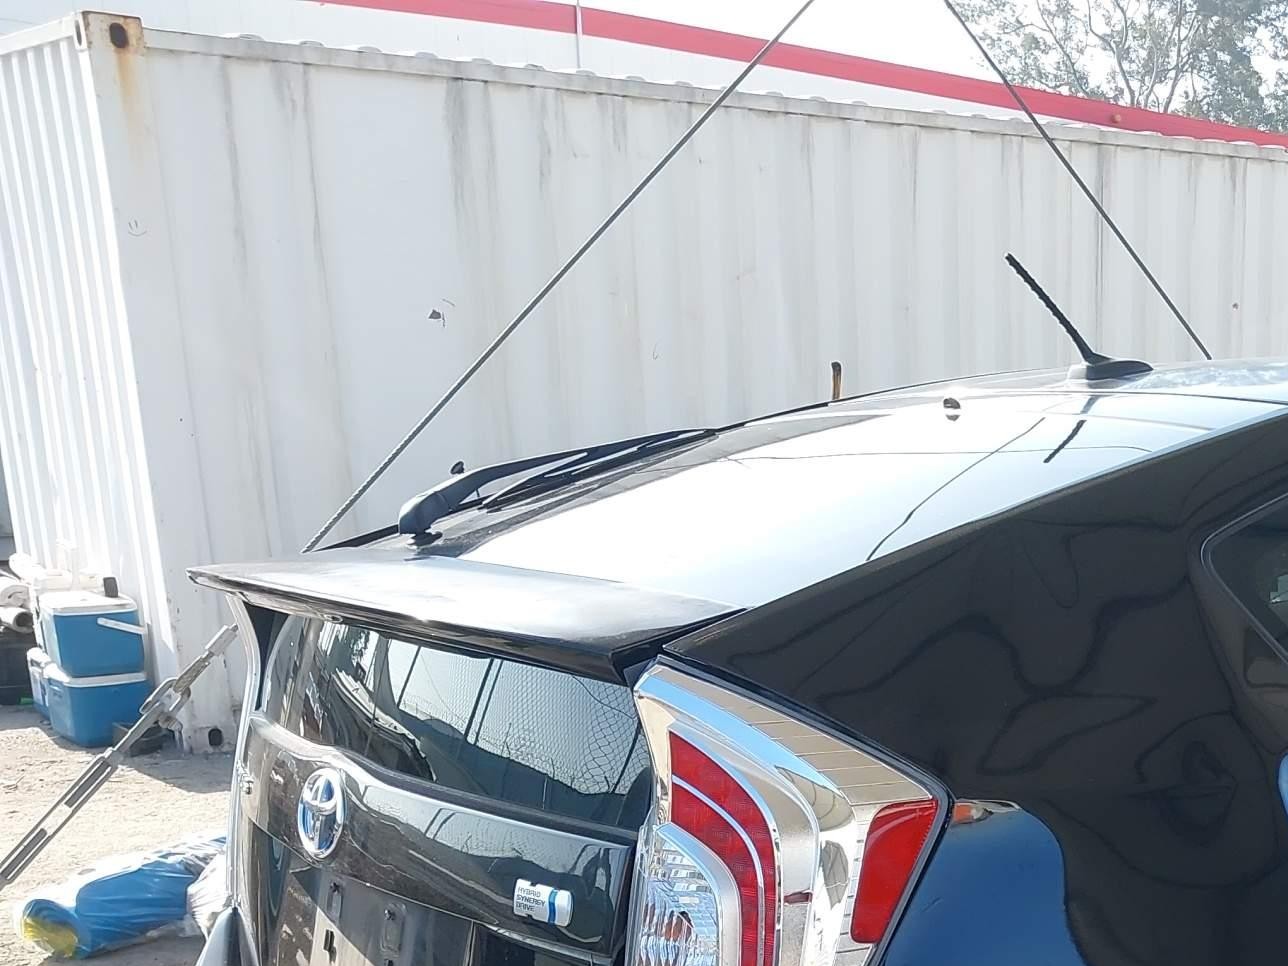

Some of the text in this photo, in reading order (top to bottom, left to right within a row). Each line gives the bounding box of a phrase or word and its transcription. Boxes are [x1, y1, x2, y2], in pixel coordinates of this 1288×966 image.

[517, 887, 541, 898] HYBRID
[516, 894, 546, 907] SYNERGY
[515, 902, 536, 912] DRIVE
